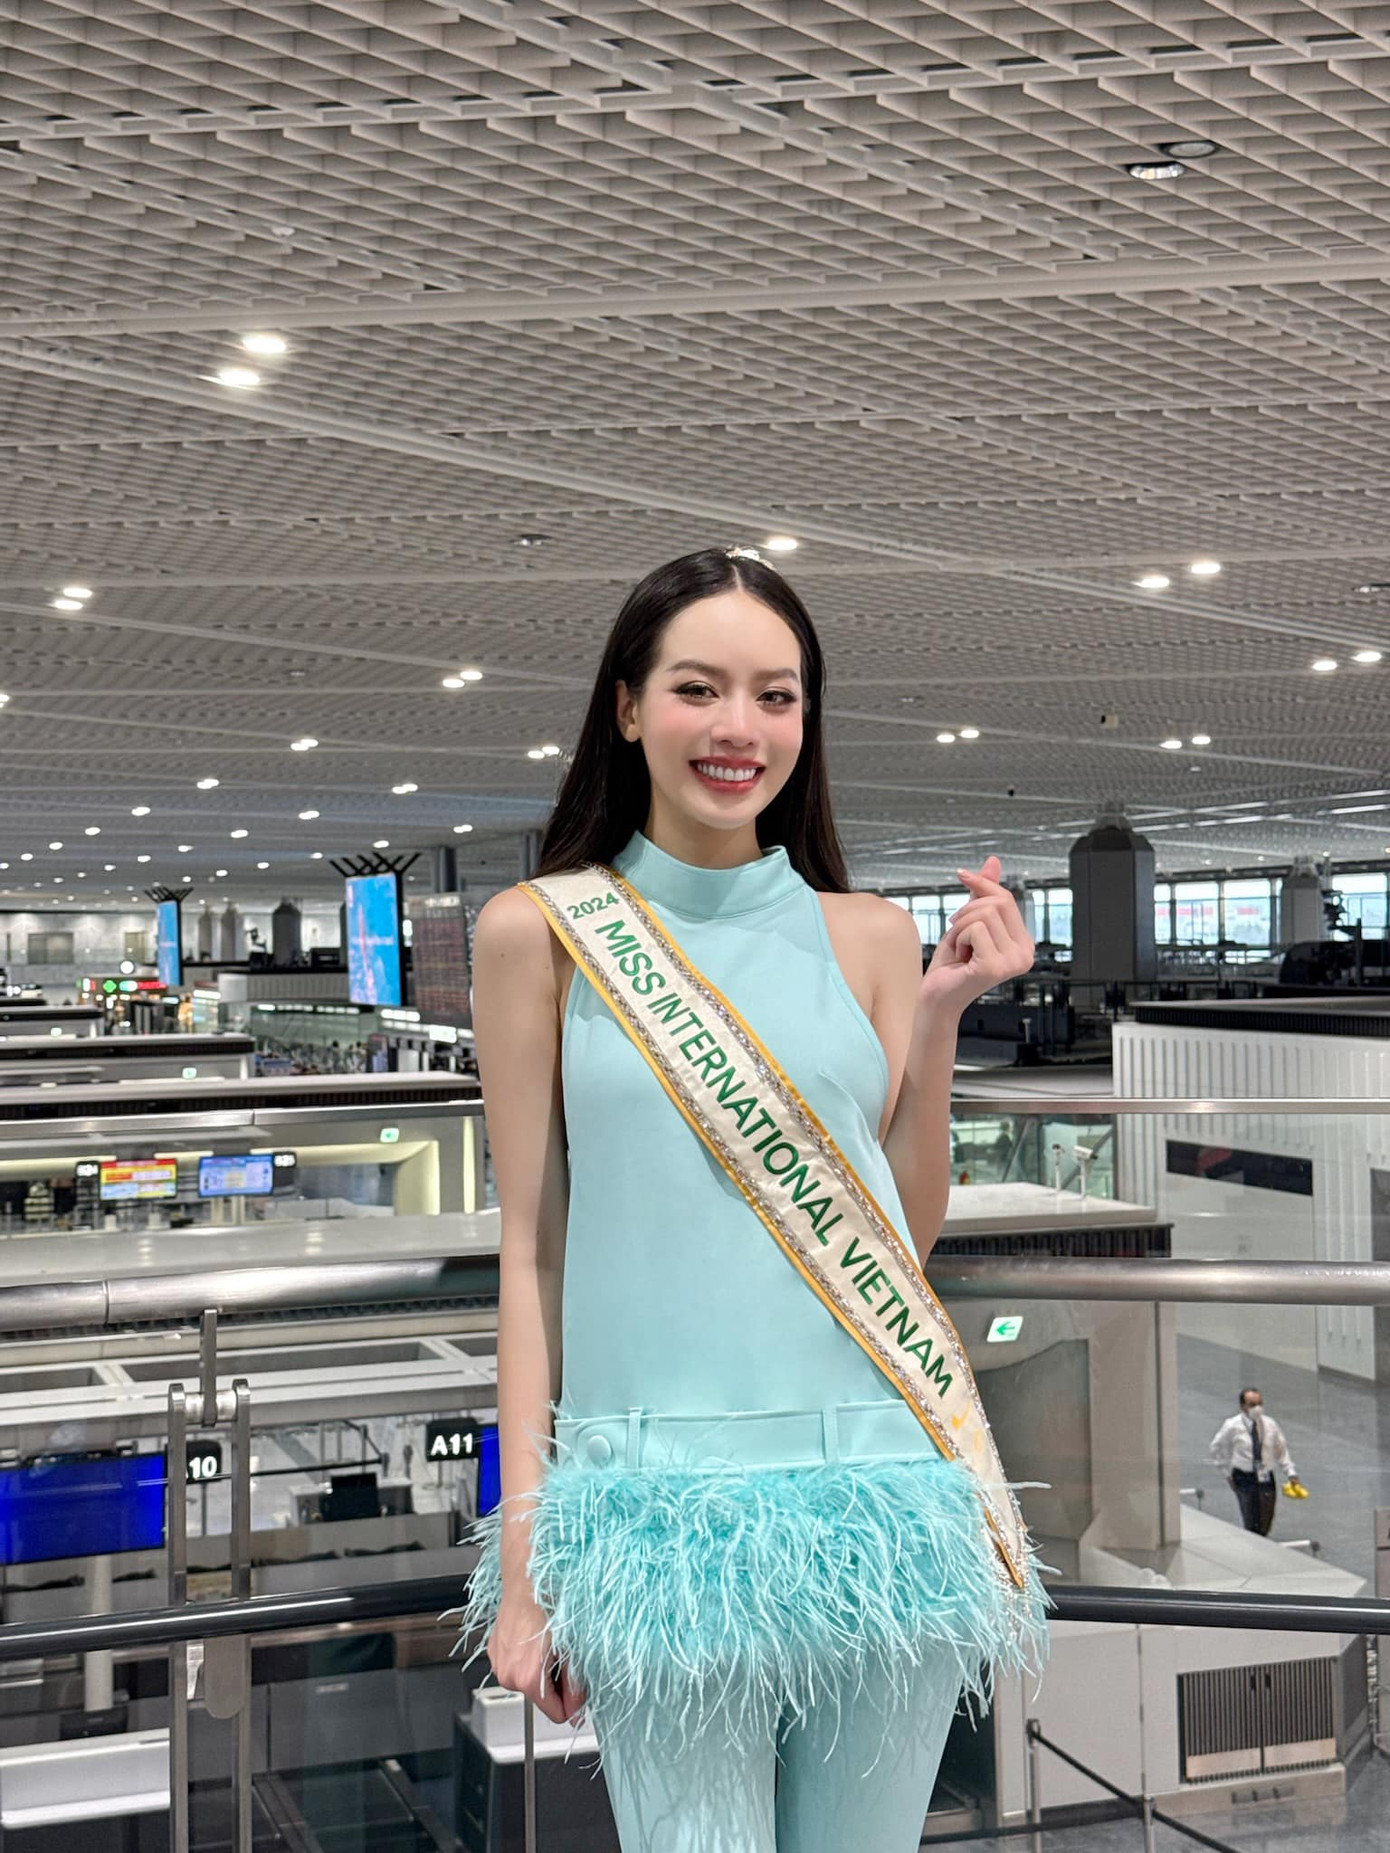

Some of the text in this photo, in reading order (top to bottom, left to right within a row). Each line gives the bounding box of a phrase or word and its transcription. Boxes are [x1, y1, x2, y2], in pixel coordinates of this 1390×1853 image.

[567, 892, 619, 919] 2024
[594, 919, 953, 1398] MISS INTERNATIONAL VIETNAM
[430, 1433, 473, 1456] A11
[186, 1456, 217, 1479] 10
